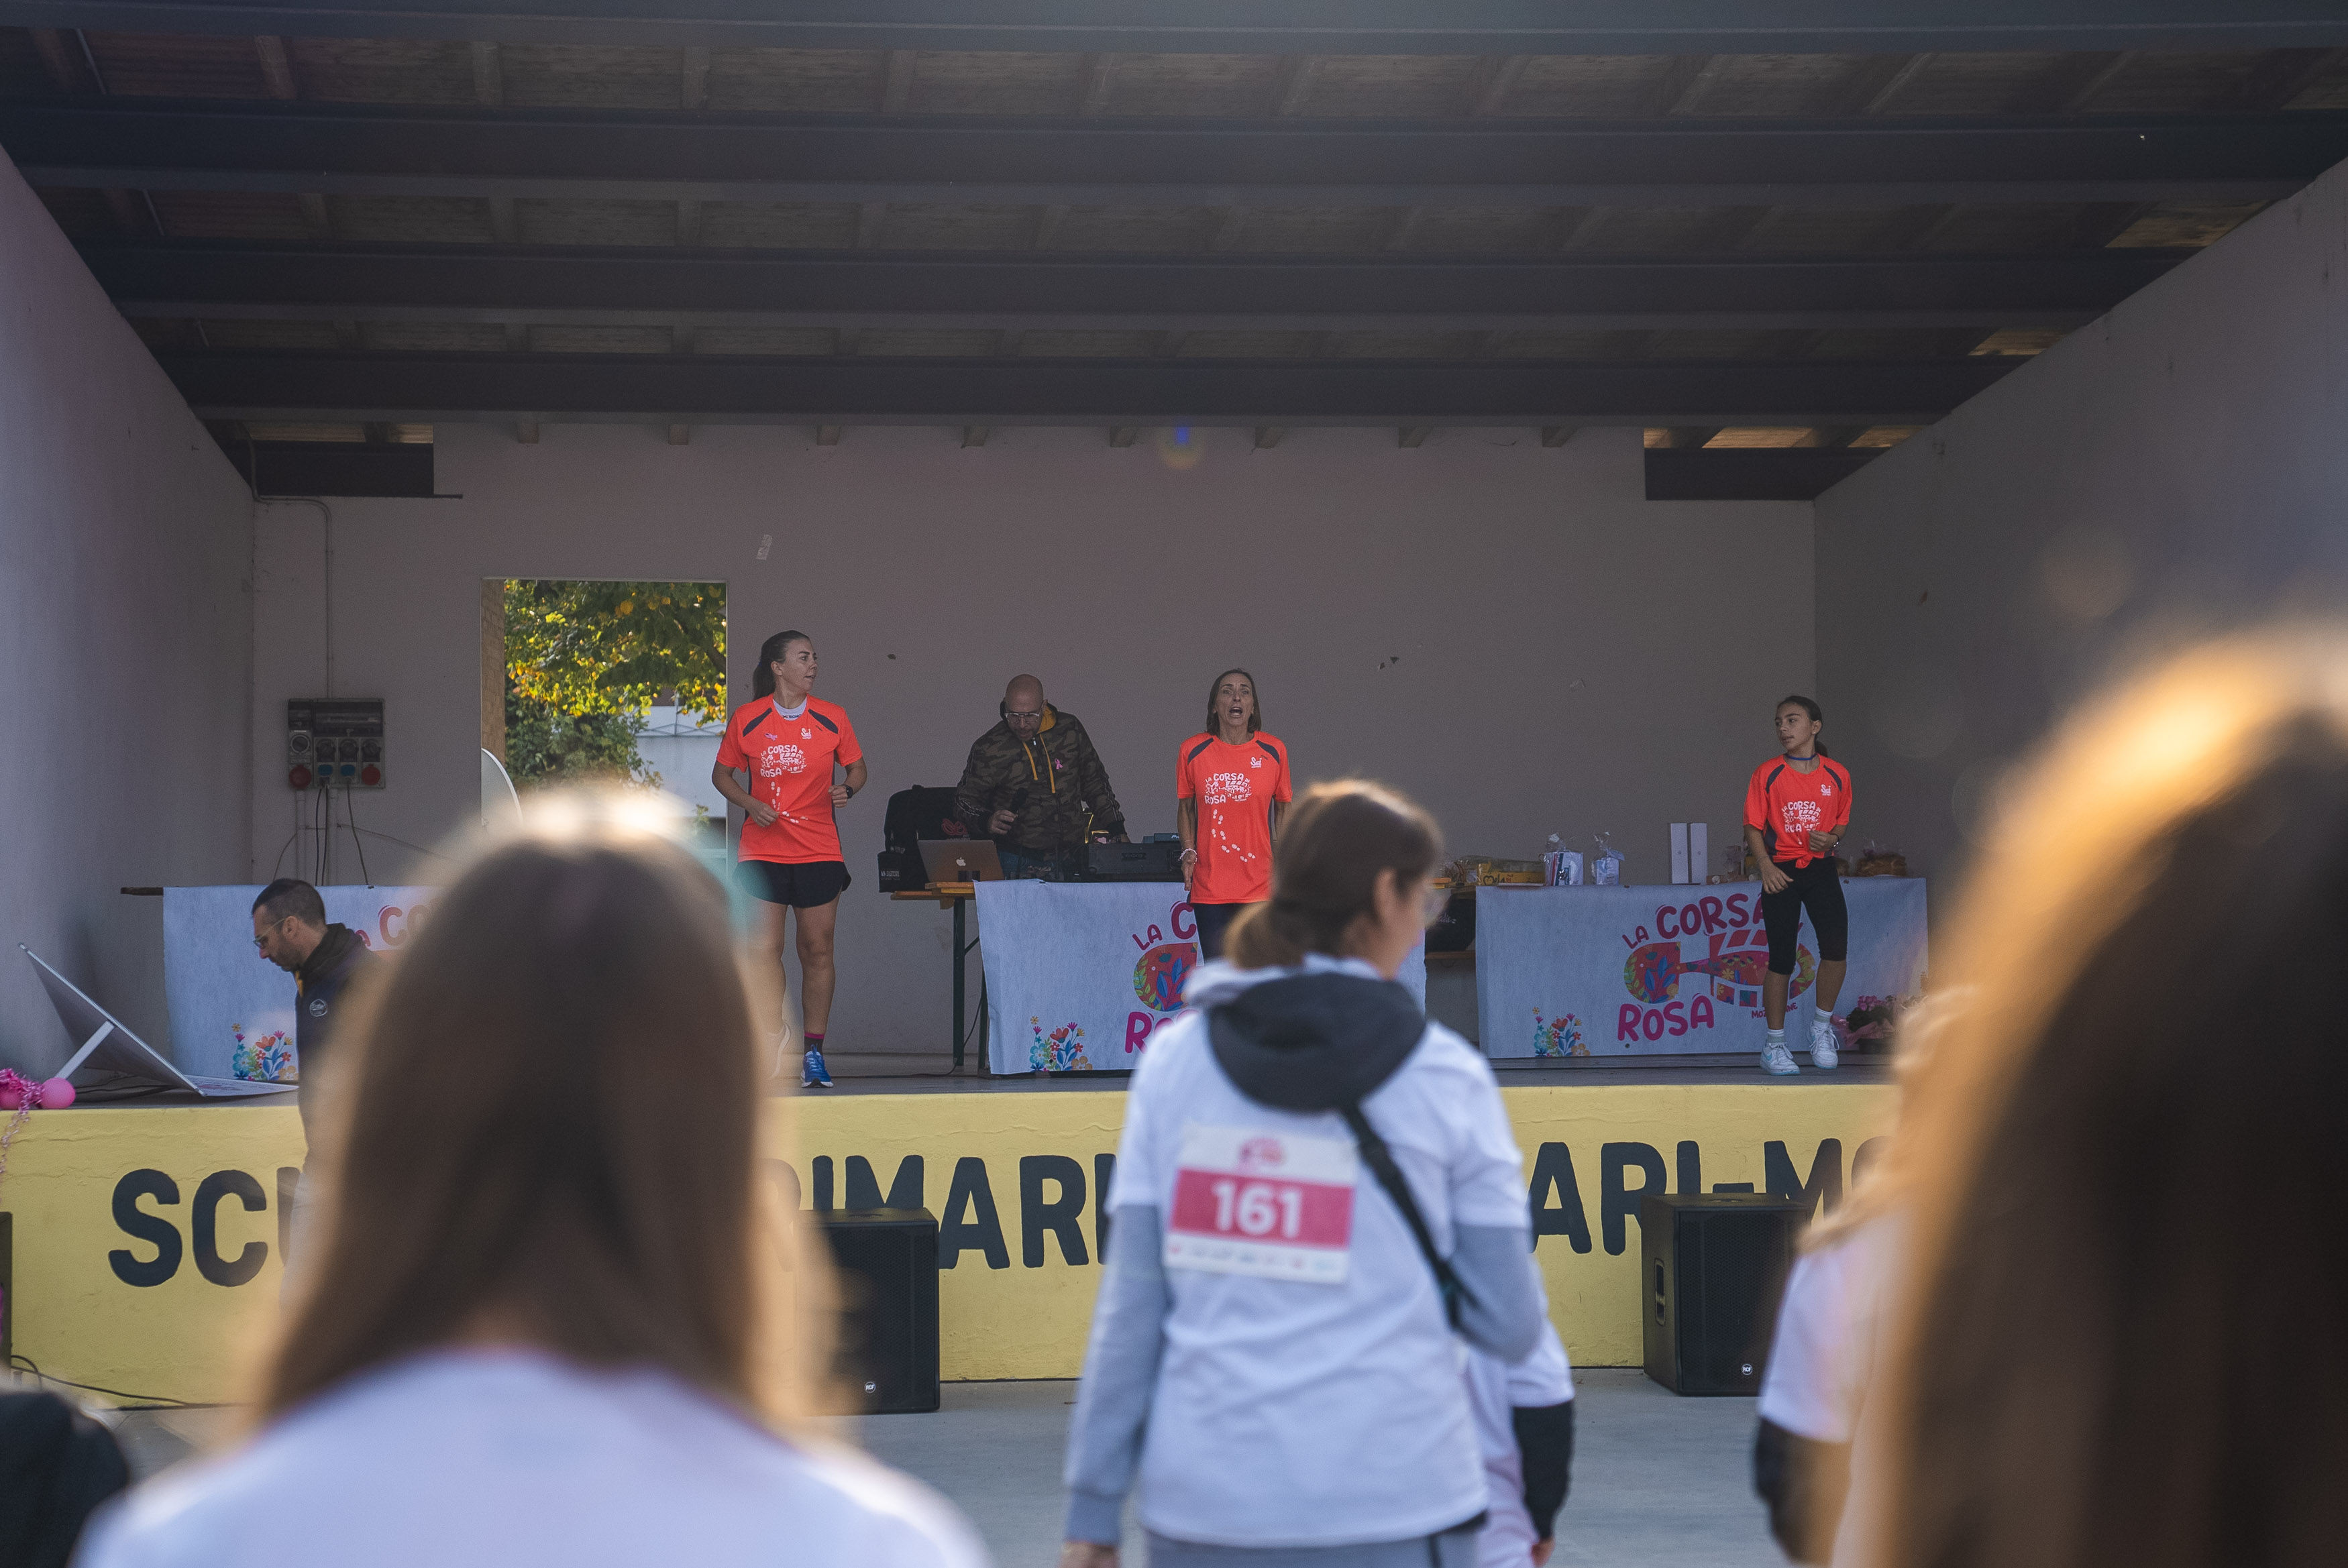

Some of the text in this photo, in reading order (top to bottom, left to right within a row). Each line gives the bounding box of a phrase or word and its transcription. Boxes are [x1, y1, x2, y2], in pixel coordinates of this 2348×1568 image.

[767, 744, 798, 754] CORSA
[760, 767, 782, 778] ROSA
[1213, 773, 1244, 781] CORSA
[1204, 794, 1226, 805] ROSA
[1788, 801, 1816, 810] CORSA
[1132, 923, 1163, 951] LA
[1621, 925, 1650, 949] LA
[1617, 994, 1715, 1042] ROSA
[1211, 1179, 1302, 1238] 161
